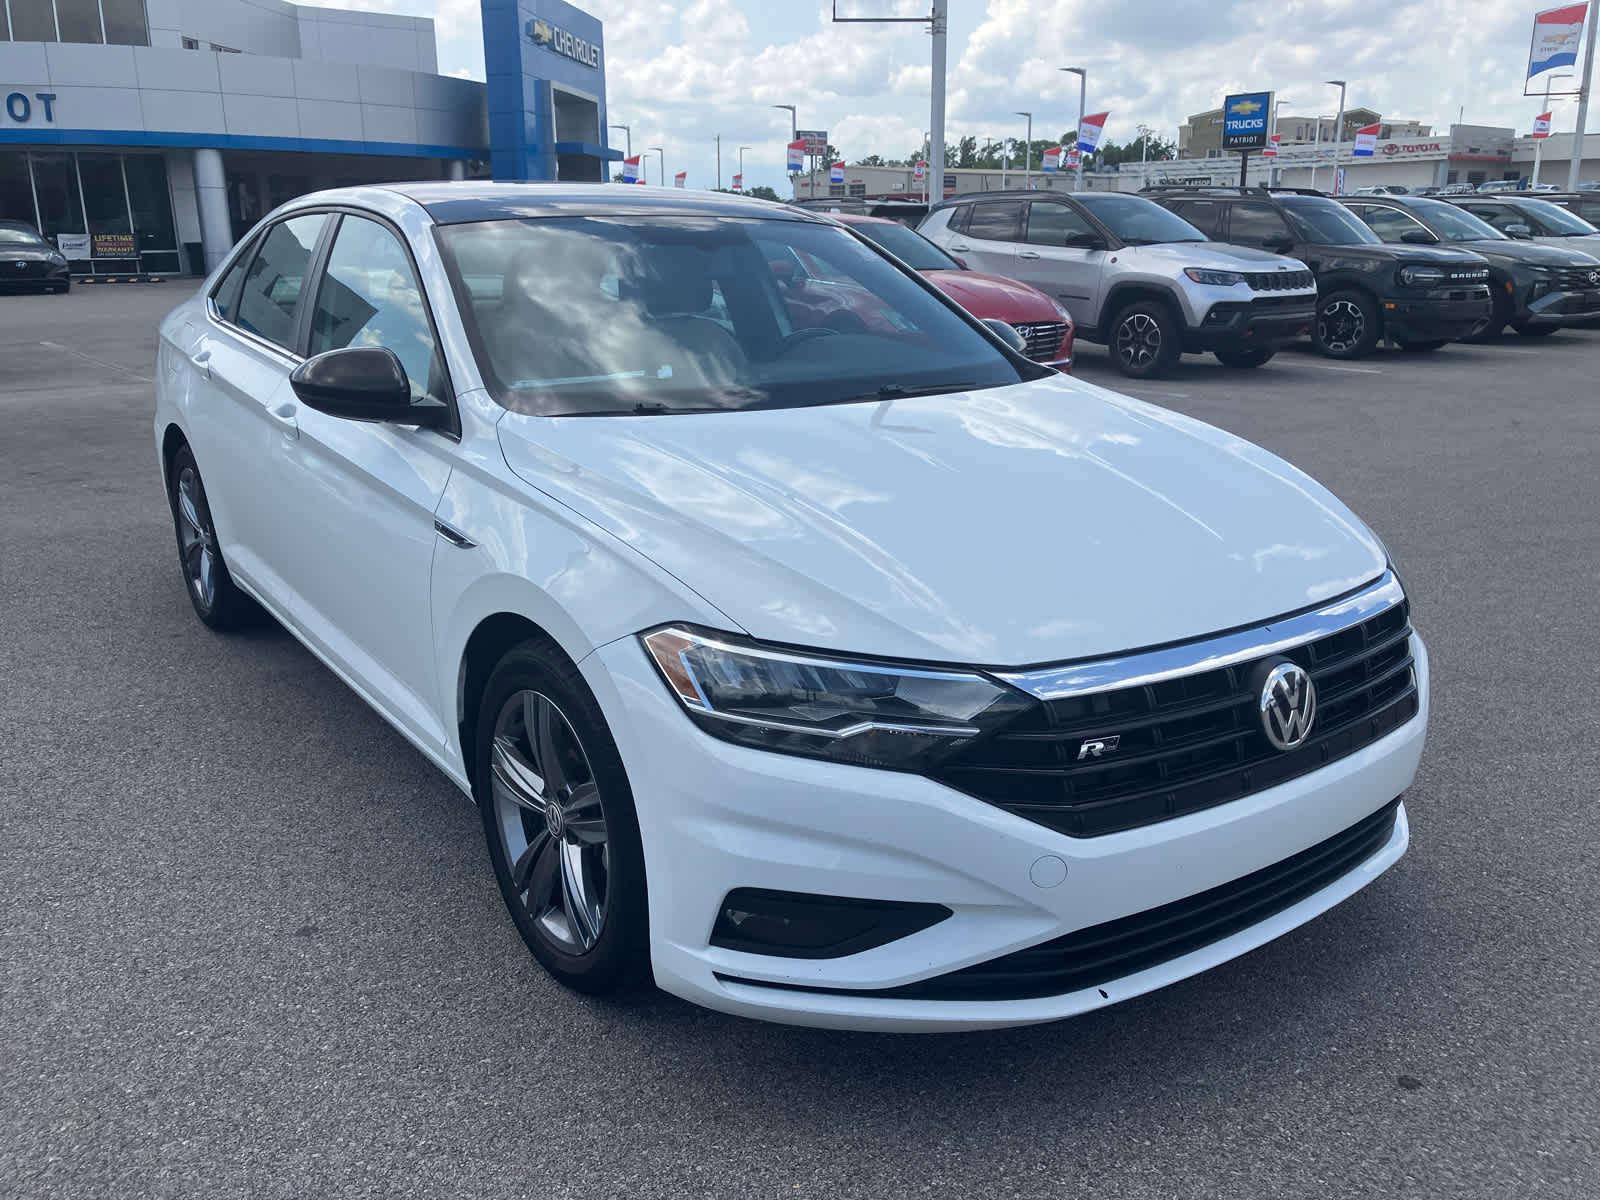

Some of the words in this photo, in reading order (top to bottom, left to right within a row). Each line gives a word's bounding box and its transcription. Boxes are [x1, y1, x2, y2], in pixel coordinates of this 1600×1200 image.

[553, 26, 600, 70] CHEVROLET
[1226, 119, 1263, 130] TRUCKS
[1229, 136, 1257, 144] PATRIOT
[1402, 143, 1440, 152] TOYOTA
